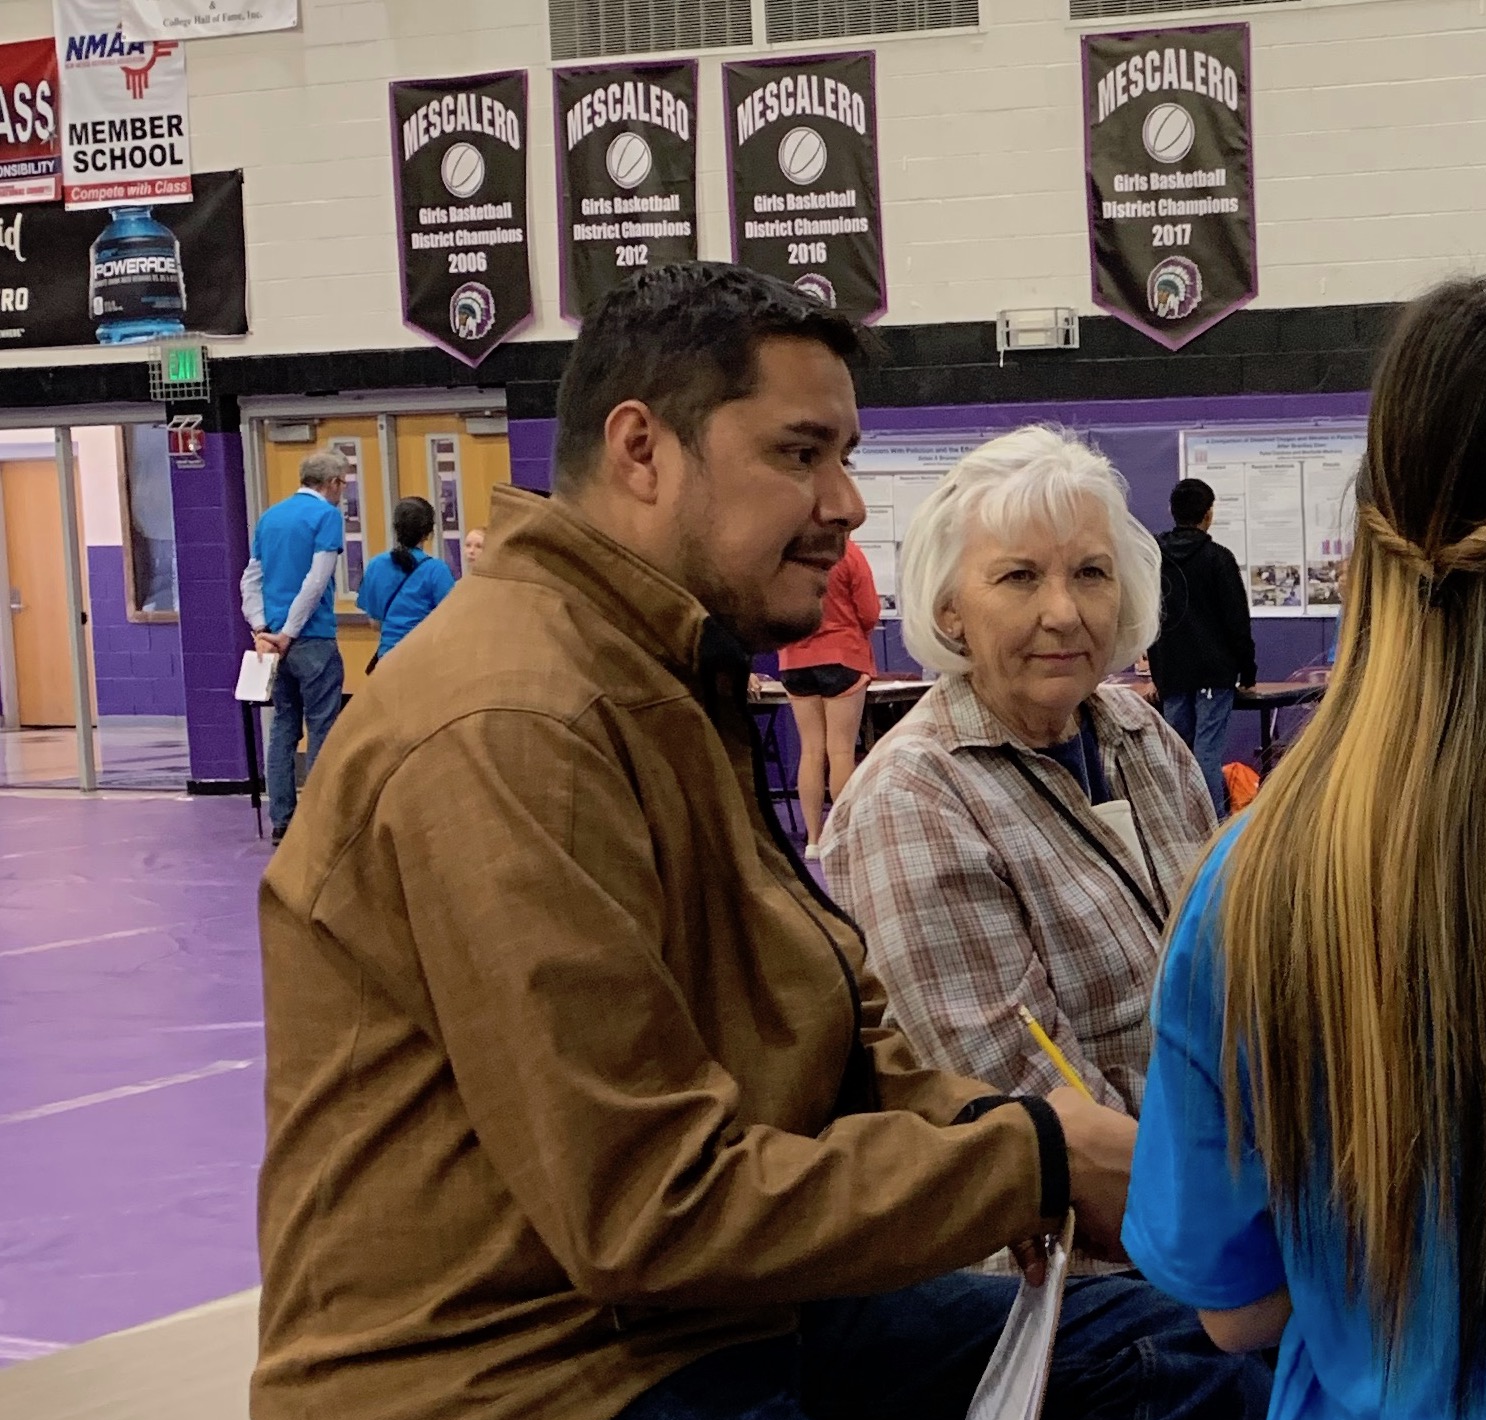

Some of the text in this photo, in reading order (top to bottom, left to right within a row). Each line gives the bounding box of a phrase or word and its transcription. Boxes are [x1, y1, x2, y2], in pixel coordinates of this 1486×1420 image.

[208, 0, 216, 10] &
[163, 10, 263, 28] College Hall of Fame, Inc.
[66, 31, 145, 62] NMAA
[1098, 47, 1239, 124] MESCALERO
[566, 80, 690, 152] MESCALERO
[737, 74, 867, 147] MESCALERO
[68, 114, 184, 146] MEMBER
[403, 92, 520, 162] MESCALERO
[72, 142, 184, 174] SCHOOL
[71, 185, 125, 202] Compete
[127, 182, 151, 197] with
[155, 179, 187, 195] Class
[1114, 168, 1226, 192] Girls Basketball
[581, 194, 680, 216] Girls Basketball
[753, 189, 856, 213] Girls Basketball
[1102, 196, 1239, 219] District Champions
[418, 201, 513, 226] Girls Basketball
[411, 226, 523, 250] District Champions
[573, 219, 692, 241] District Champions
[744, 216, 869, 239] District Champions
[1152, 223, 1192, 247] 2017
[448, 251, 488, 274] 2006
[615, 243, 648, 267] 2012
[788, 242, 827, 264] 2016
[94, 256, 178, 280] POWERADE
